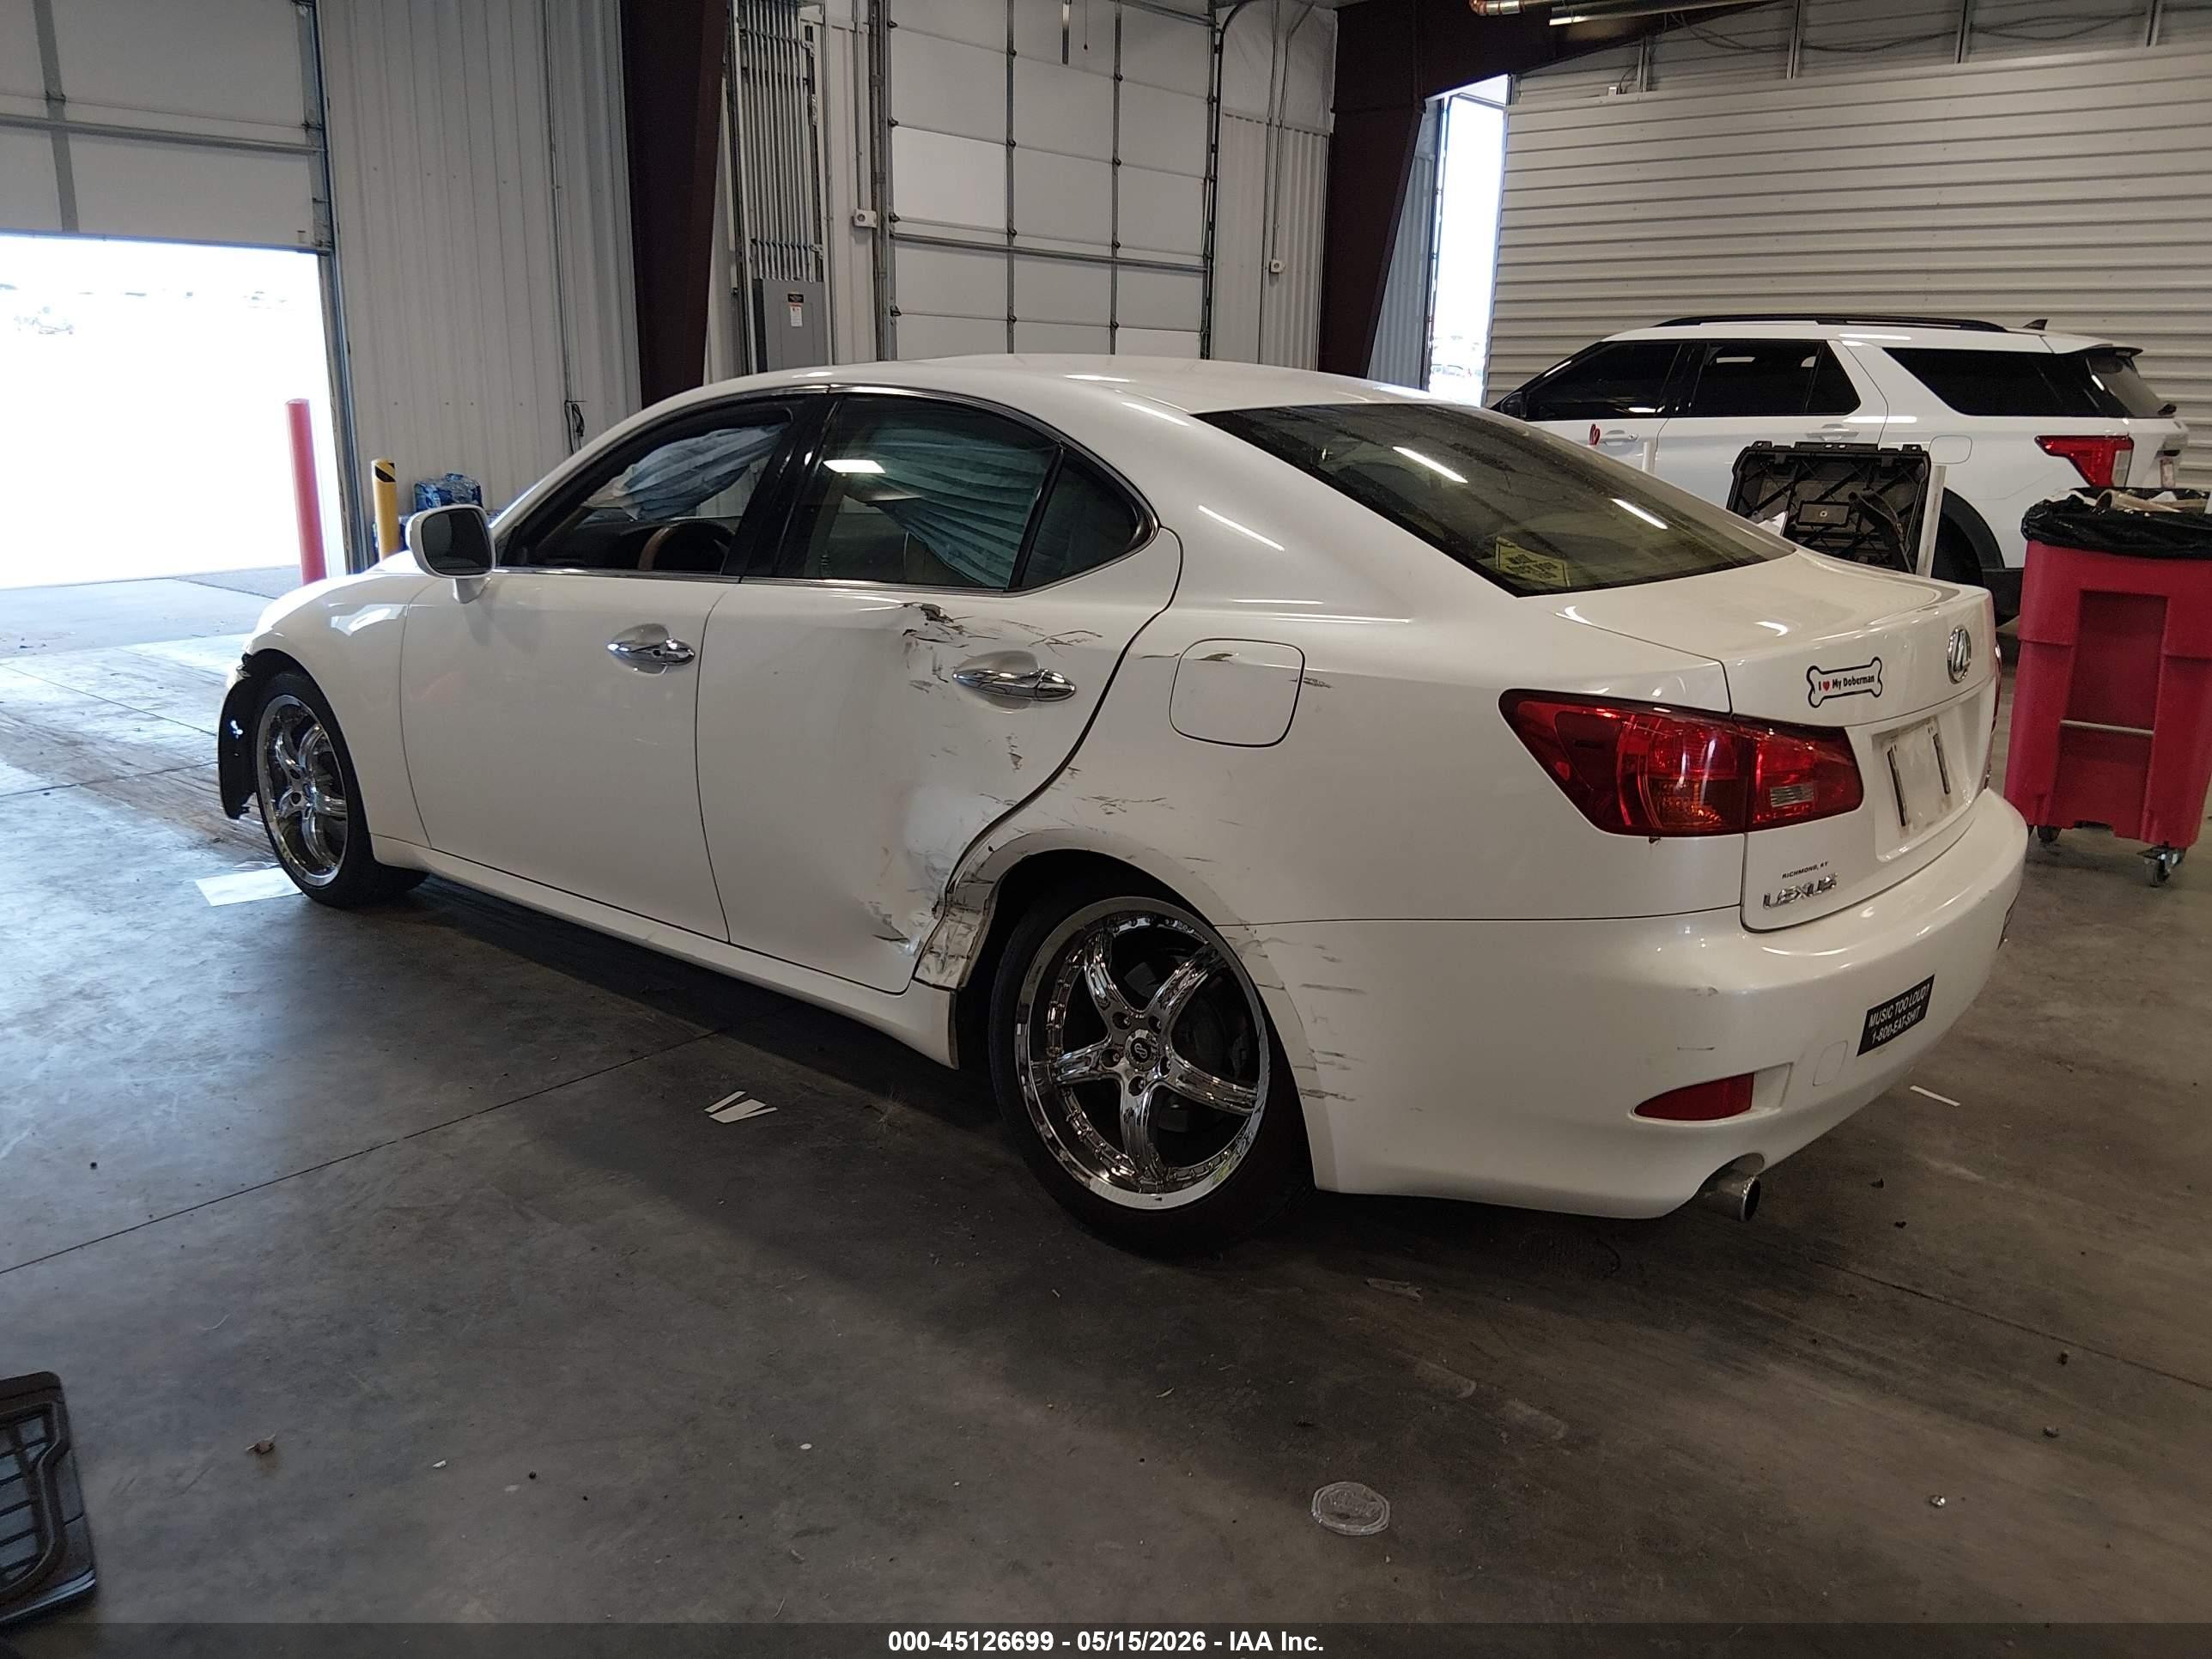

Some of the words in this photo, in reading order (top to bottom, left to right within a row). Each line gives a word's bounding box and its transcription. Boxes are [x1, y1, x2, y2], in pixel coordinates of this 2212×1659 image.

[1832, 678, 1842, 690] My
[1843, 675, 1875, 687] Doberman
[1763, 872, 1838, 909] LEXUS
[1869, 1004, 1894, 1029] MUSIC
[1894, 996, 1909, 1016] TOO
[1872, 1005, 1922, 1045] 1-800-EAT-SHIT
